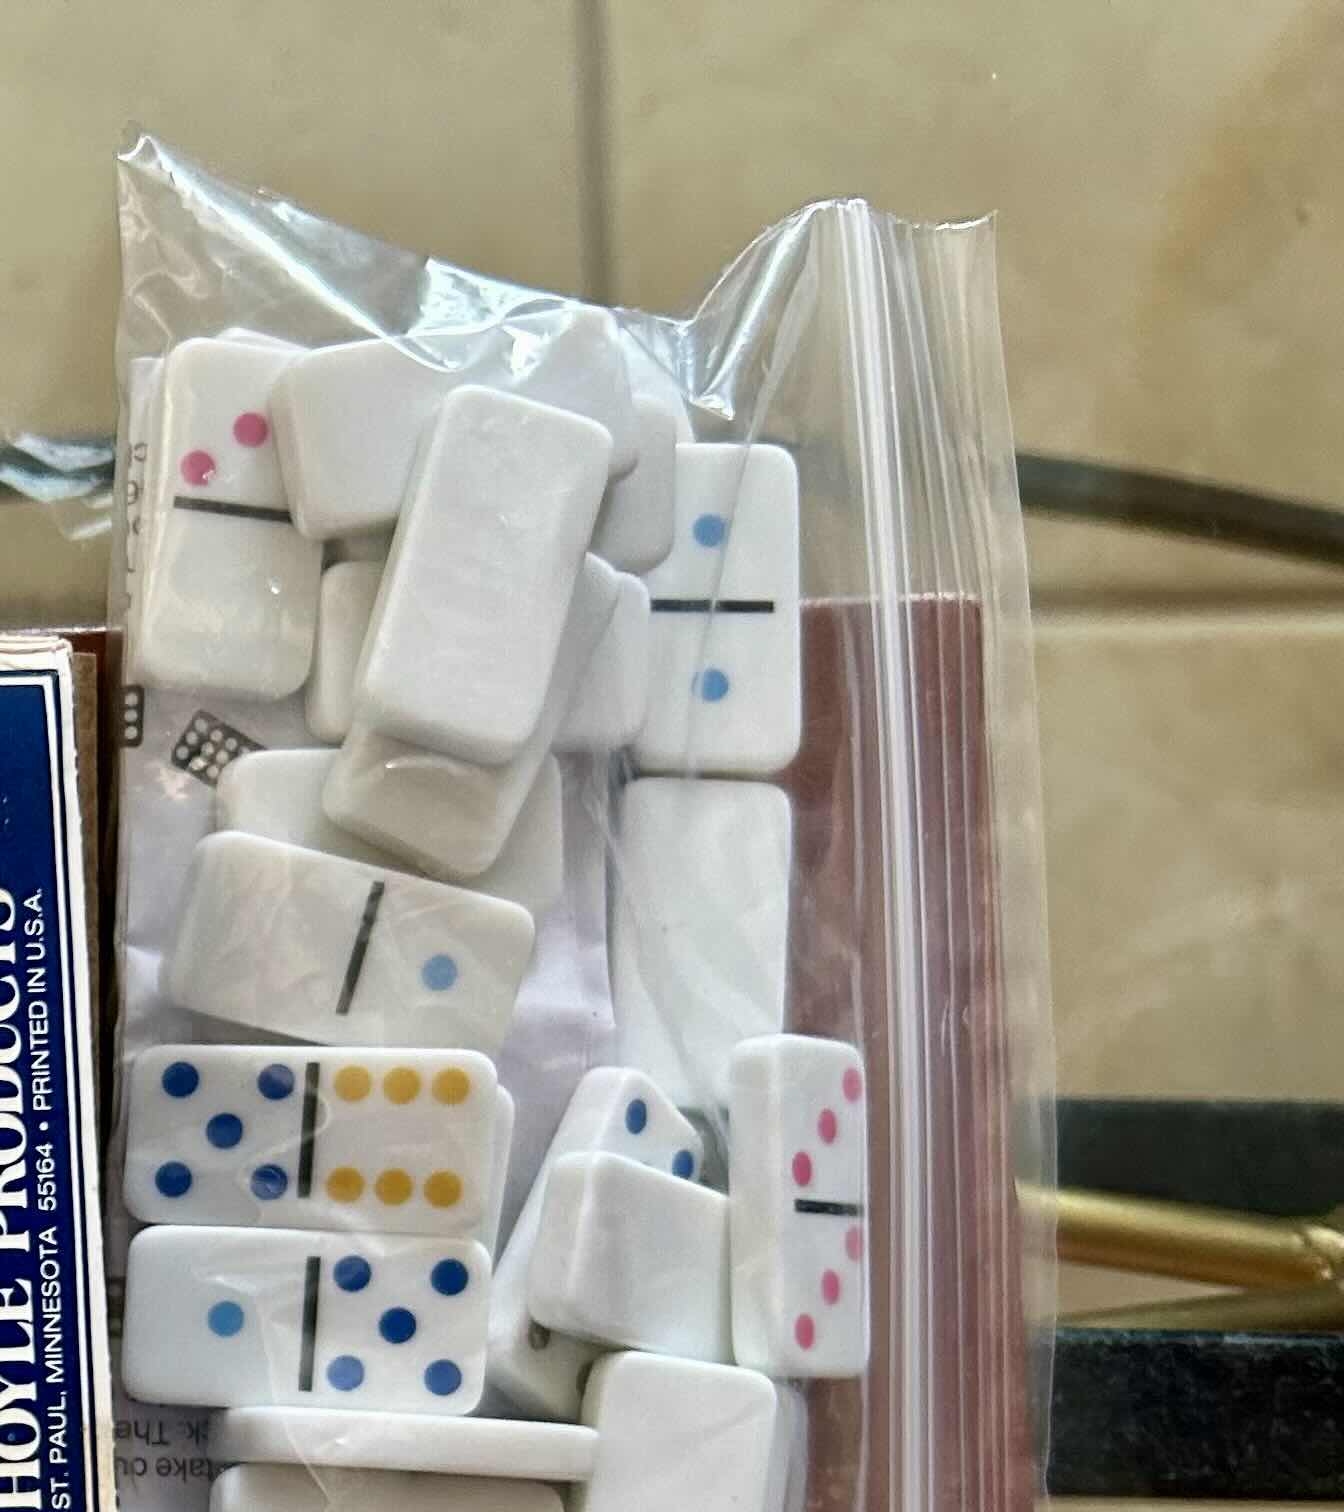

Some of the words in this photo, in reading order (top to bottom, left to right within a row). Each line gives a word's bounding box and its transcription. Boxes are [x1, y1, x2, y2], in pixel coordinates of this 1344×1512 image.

[23, 887, 47, 959] U.S.A.
[25, 965, 48, 993] IN
[28, 1000, 53, 1111] PRINTED
[35, 1143, 57, 1211] 55164
[38, 1226, 65, 1383] MINNESOTA
[47, 1390, 69, 1457] PAUL,
[49, 1470, 72, 1510] ST.
